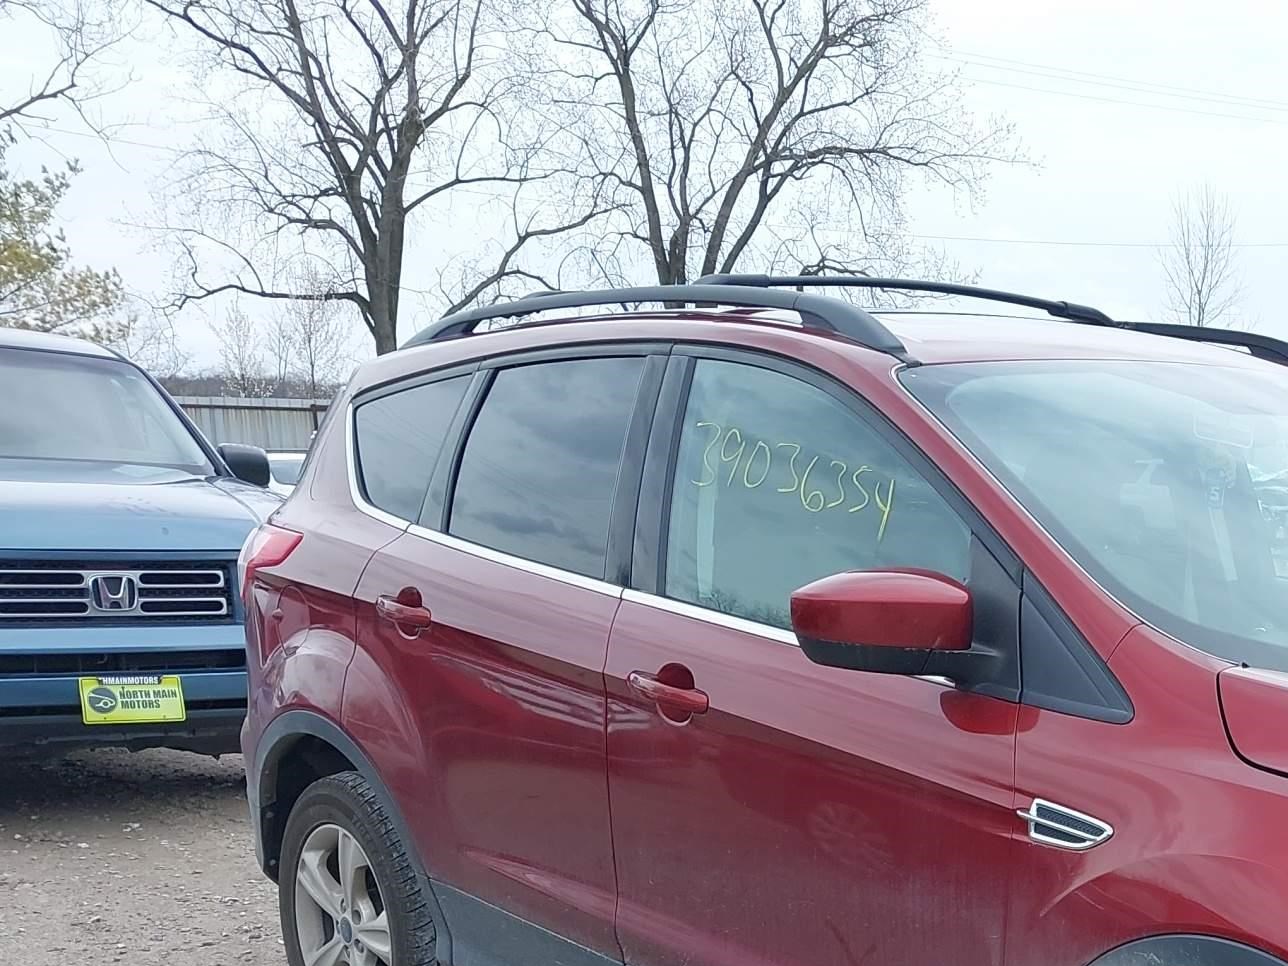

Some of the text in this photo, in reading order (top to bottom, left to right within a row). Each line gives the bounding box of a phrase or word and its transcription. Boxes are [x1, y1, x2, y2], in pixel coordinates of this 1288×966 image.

[690, 422, 896, 542] 39036354
[119, 686, 178, 700] NORTH MAIN
[120, 699, 161, 709] MOTORS
